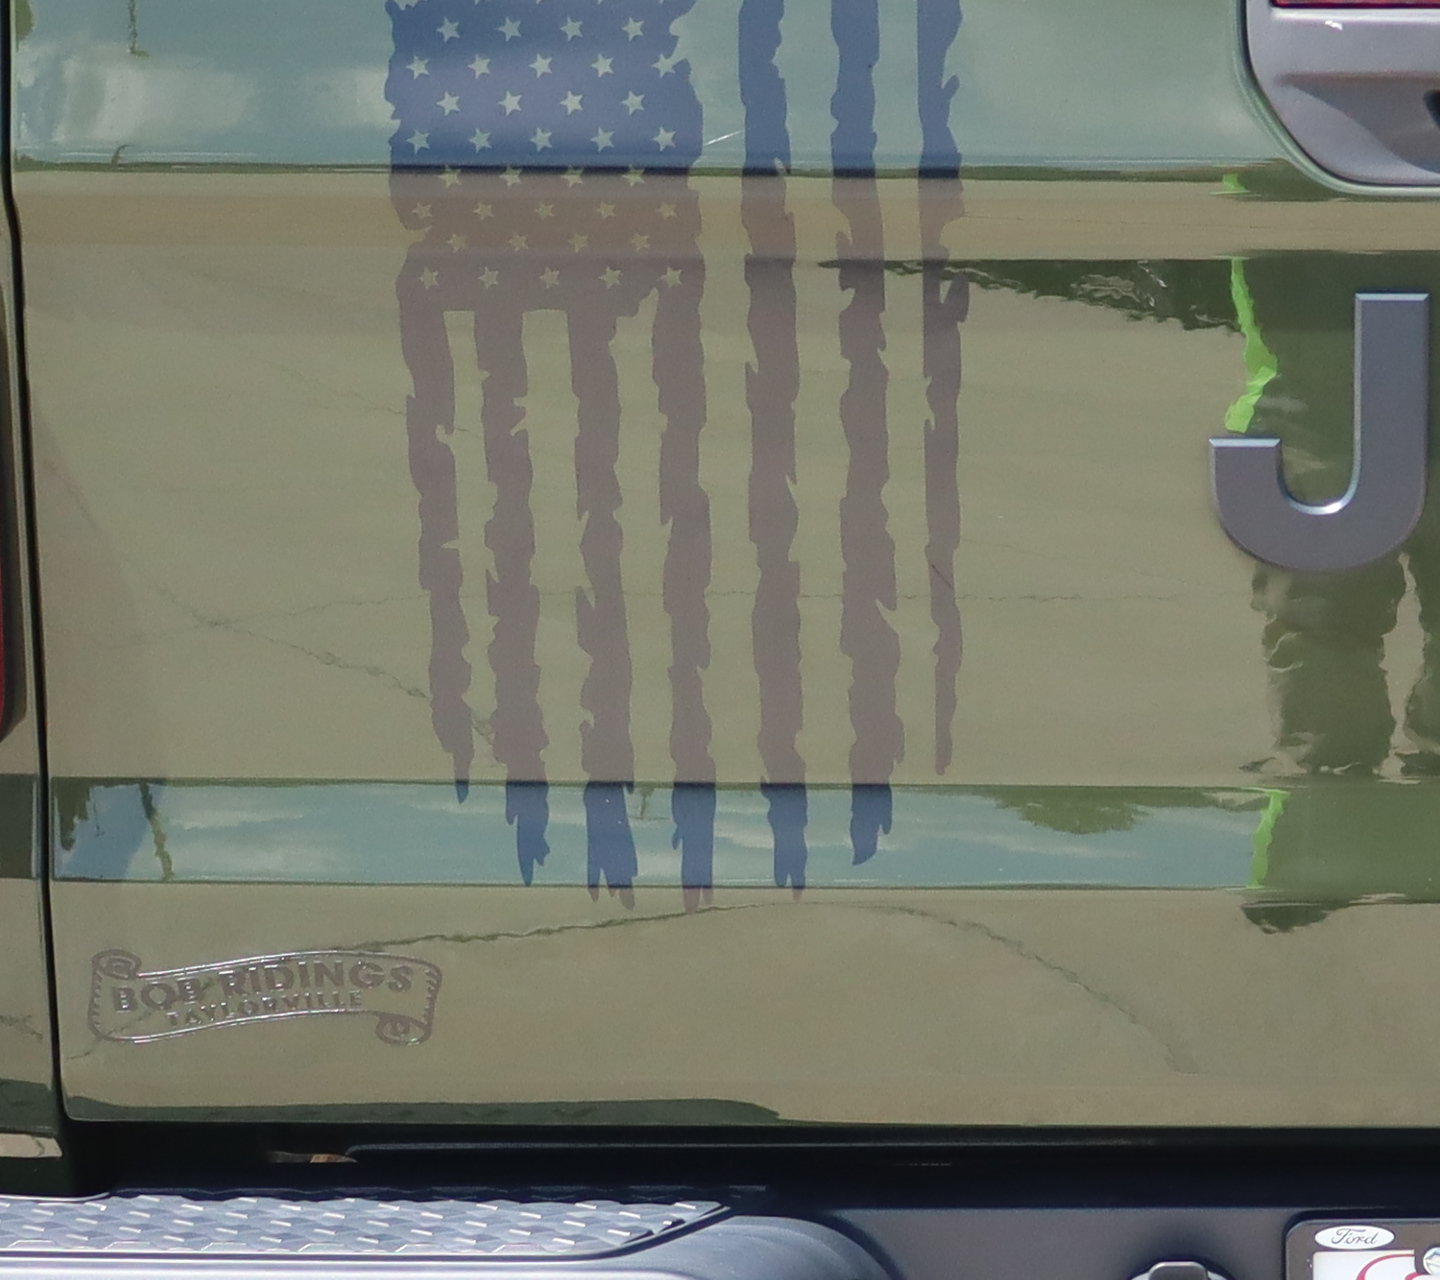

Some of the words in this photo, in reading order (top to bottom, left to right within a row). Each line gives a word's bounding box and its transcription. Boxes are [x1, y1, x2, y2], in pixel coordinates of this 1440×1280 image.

[113, 977, 205, 1012] BOB
[219, 960, 412, 997] RIDINGS
[166, 991, 362, 1026] TAYLORVILLE
[1331, 1227, 1378, 1246] Ford
